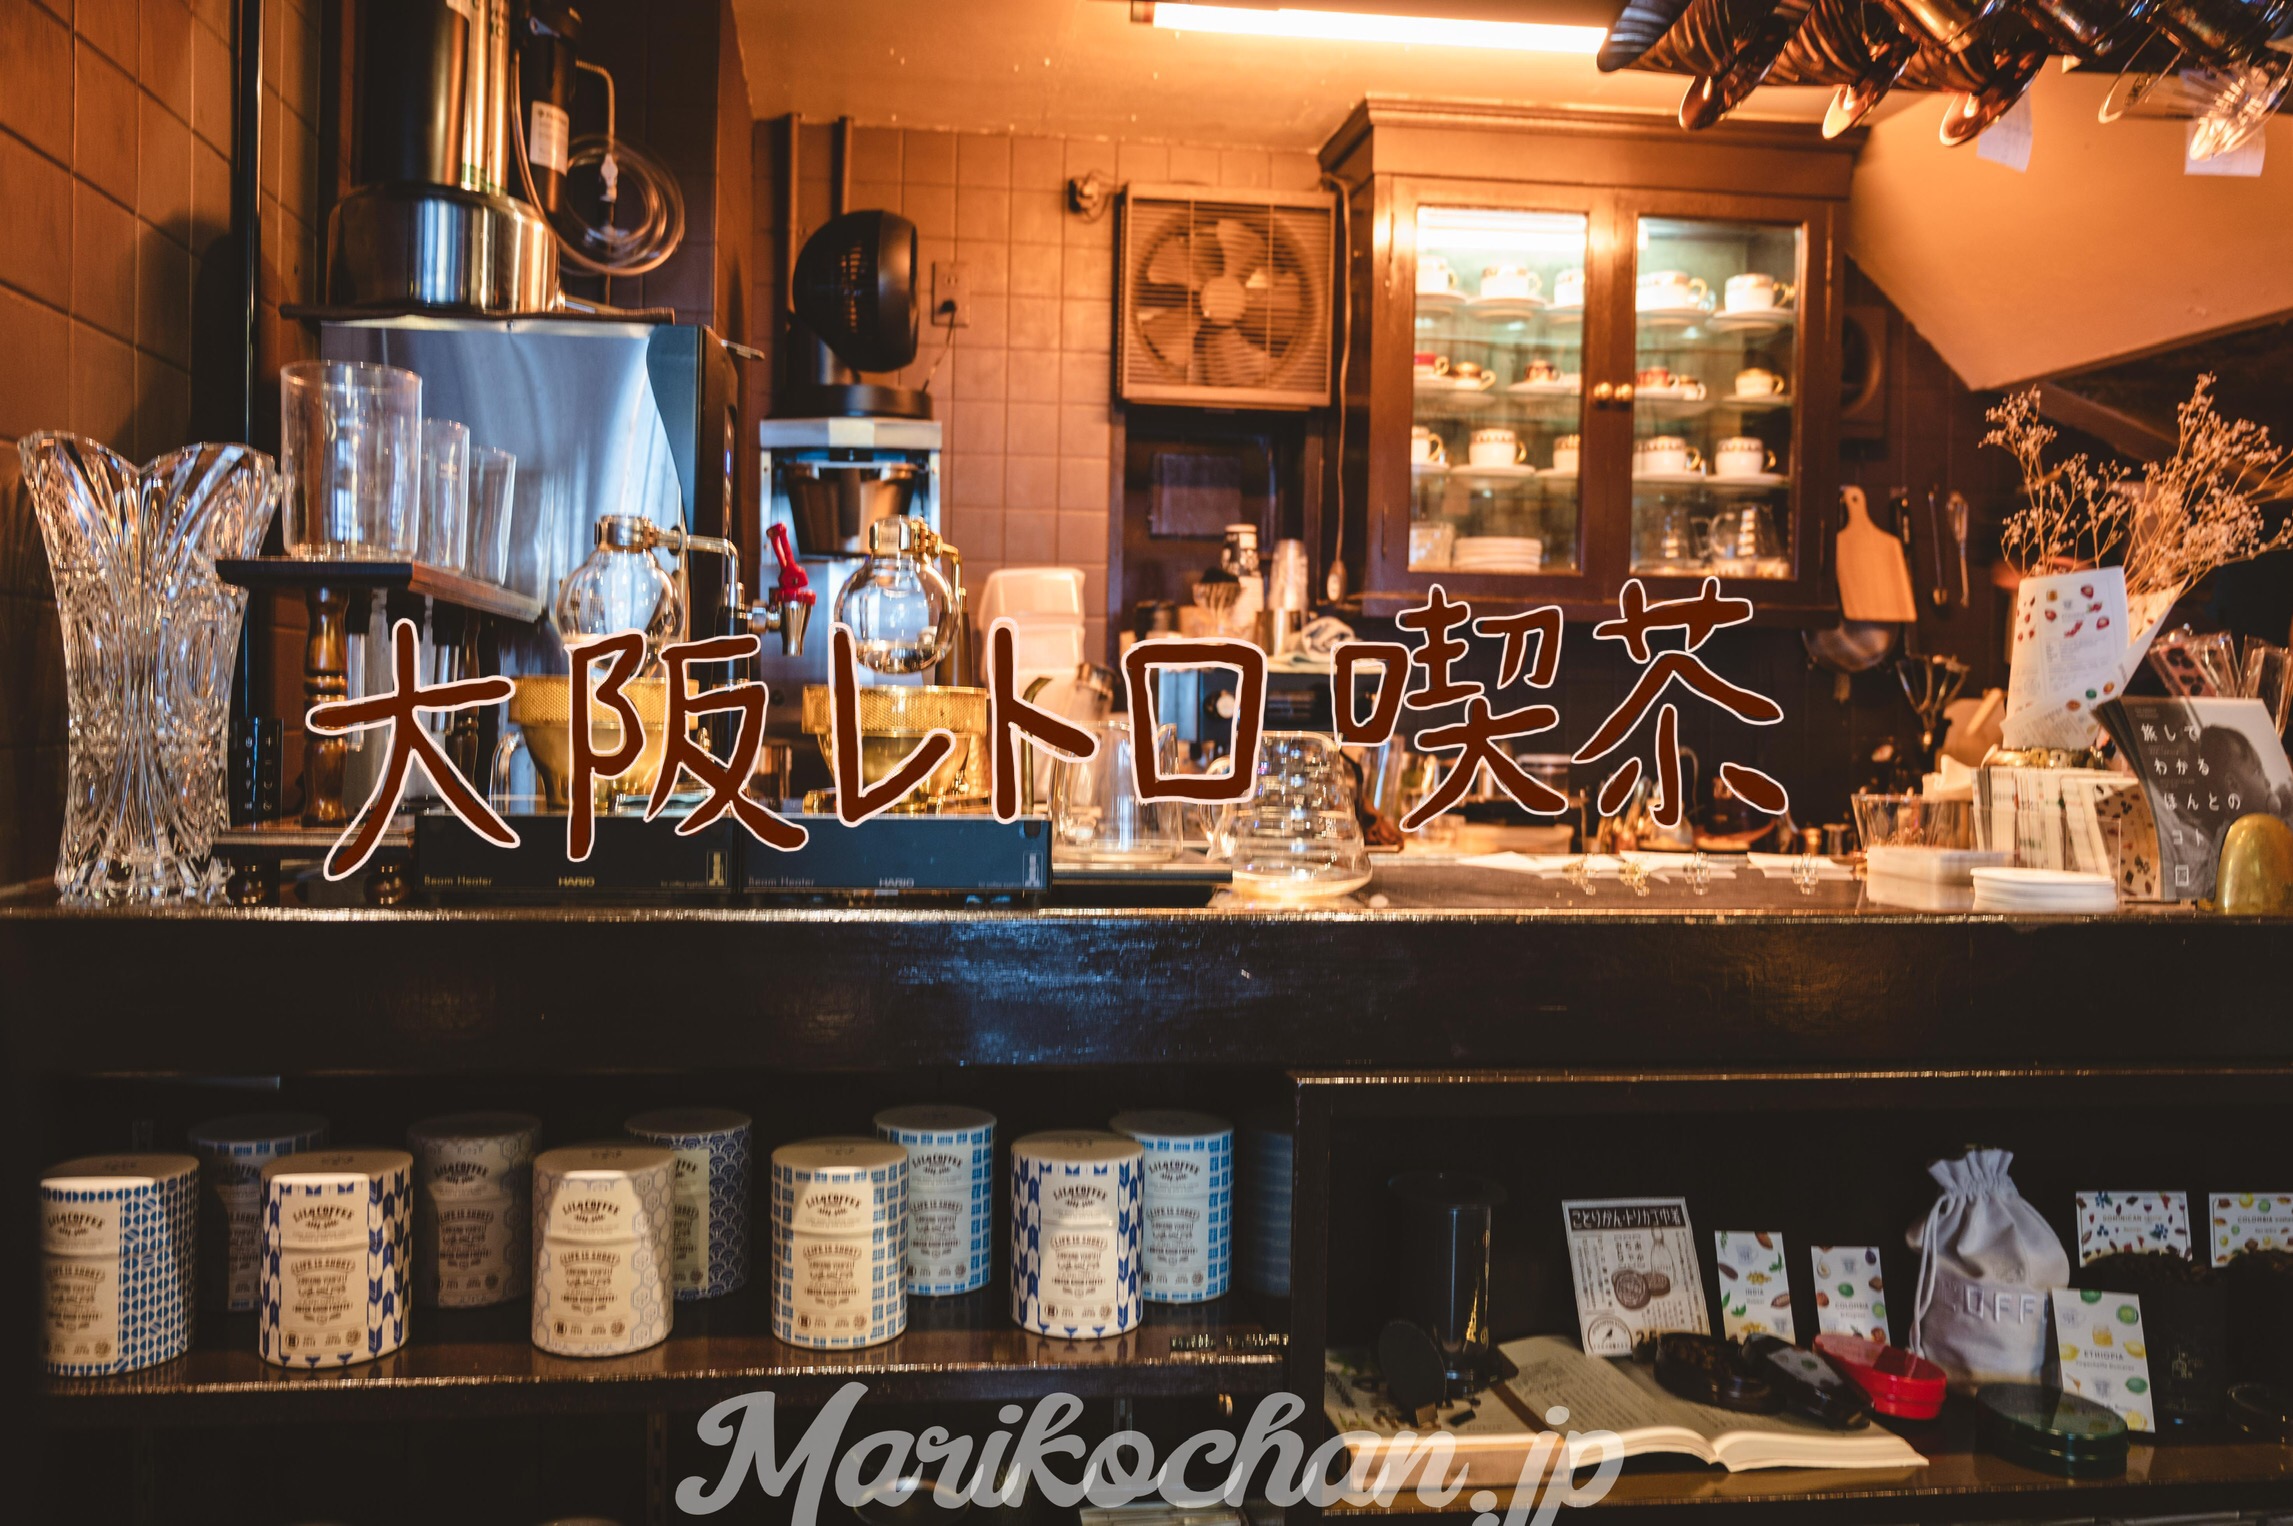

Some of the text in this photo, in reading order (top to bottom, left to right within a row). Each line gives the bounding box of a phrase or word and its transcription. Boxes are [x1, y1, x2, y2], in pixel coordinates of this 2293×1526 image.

[2154, 757, 2210, 776] わかる
[2163, 791, 2241, 811] ほんとの
[2171, 828, 2204, 847] コト
[424, 874, 493, 886] Beam Heater
[558, 876, 595, 887] HARIO
[748, 874, 815, 887] Beam Heater
[879, 877, 914, 887] HARIO
[932, 1152, 963, 1169] COFFEE
[1169, 1158, 1200, 1175] COFFEE
[1075, 1184, 1108, 1201] COFFEE
[584, 1198, 620, 1215] COFFEE
[827, 1192, 862, 1209] COFFEE
[939, 1201, 959, 1212] SHORT
[316, 1204, 355, 1222] COFFEE
[1176, 1207, 1198, 1219] SHORT
[2237, 1215, 2273, 1224] COLOMBIA
[1082, 1235, 1105, 1248] SHORT
[834, 1243, 857, 1255] SHORT
[591, 1251, 616, 1263] SHORT
[325, 1258, 351, 1271] SHORT
[1745, 1287, 1764, 1296] INDIA
[1835, 1301, 1869, 1310] COLOMBIA
[2083, 1349, 2124, 1361] ETHIOPIA
